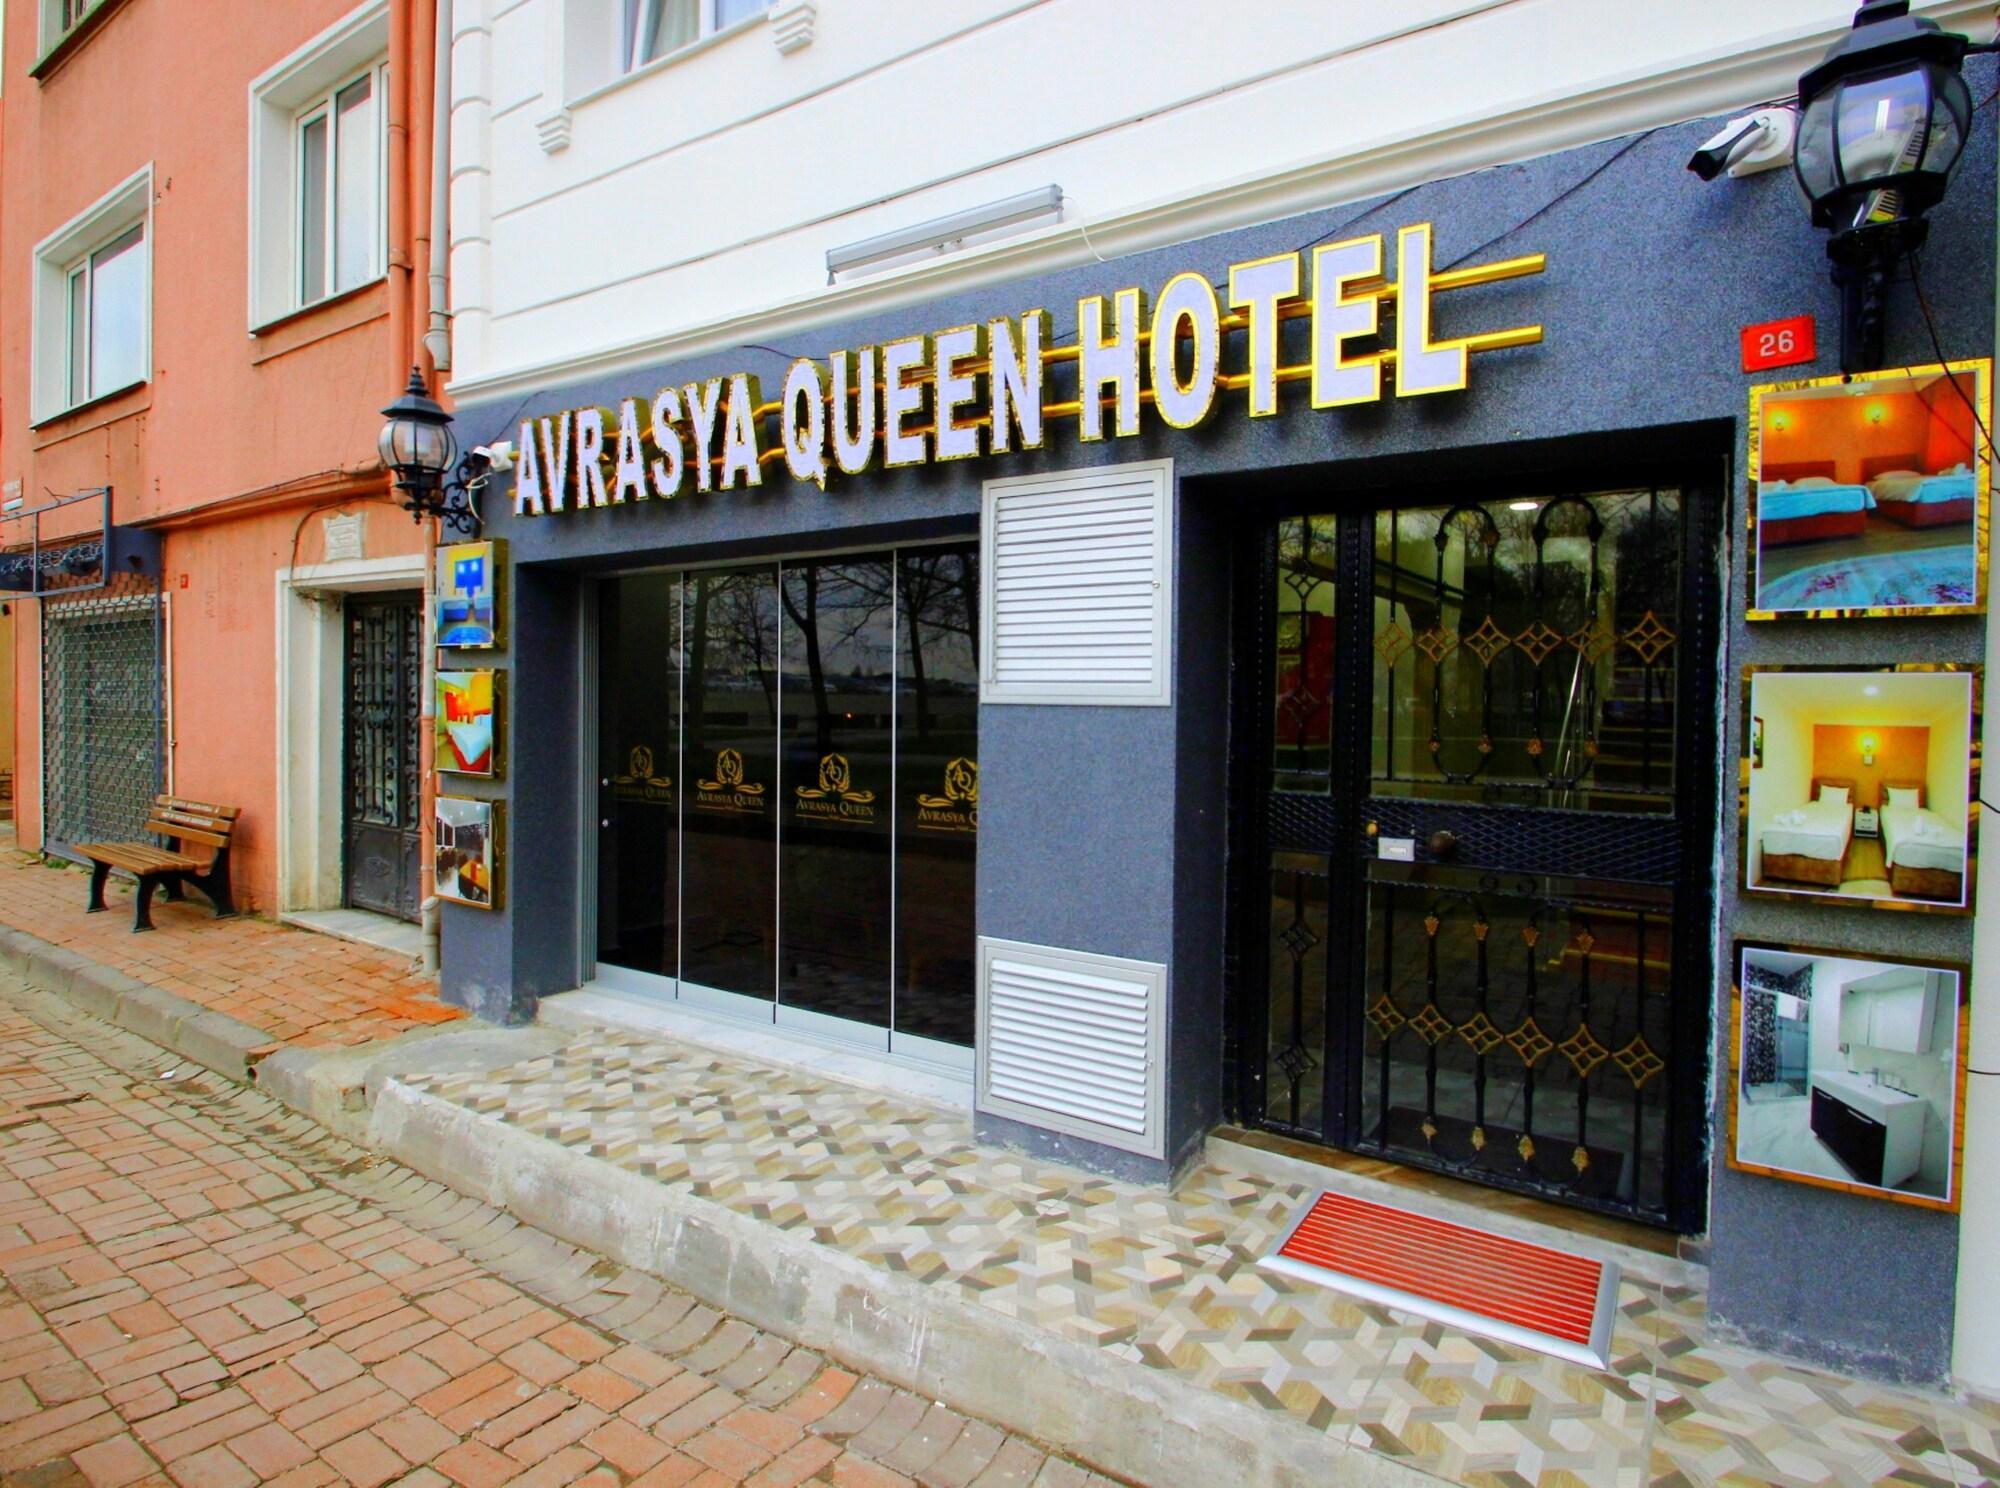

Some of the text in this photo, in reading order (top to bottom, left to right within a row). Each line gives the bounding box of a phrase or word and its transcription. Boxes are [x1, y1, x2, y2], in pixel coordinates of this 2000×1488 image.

[1759, 329, 1795, 358] 26
[512, 222, 1468, 518] AVRASYA QUEEN HOTEL
[796, 798, 874, 816] AVRASYA QUEEN
[918, 807, 966, 823] AVRASYA
